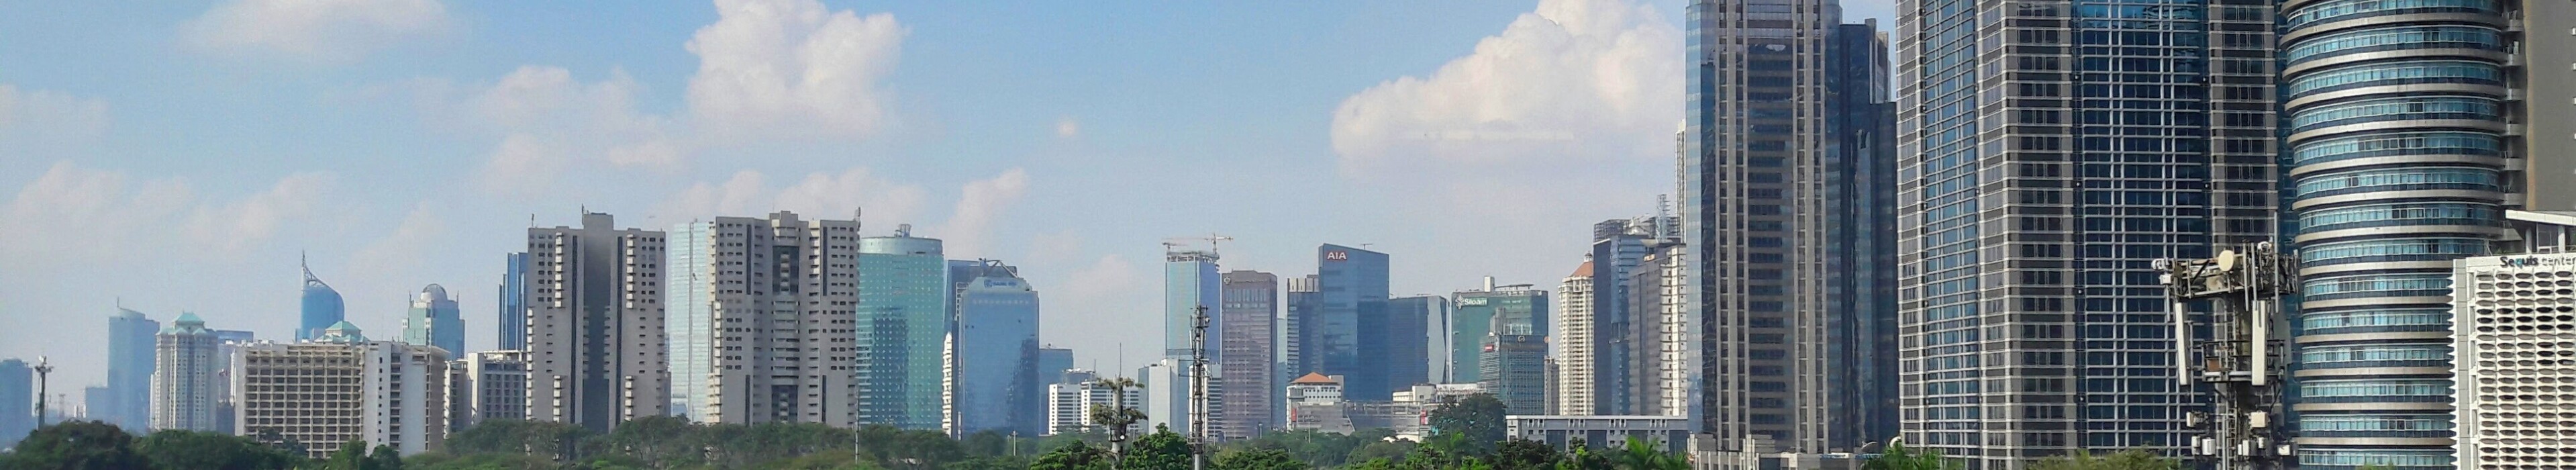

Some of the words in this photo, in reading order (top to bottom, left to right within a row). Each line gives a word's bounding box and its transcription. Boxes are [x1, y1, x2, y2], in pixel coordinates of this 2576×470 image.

[1327, 252, 1347, 260] AIA
[2500, 256, 2538, 269] Sequis
[2542, 256, 2576, 266] center
[1464, 297, 1487, 306] Siloam
